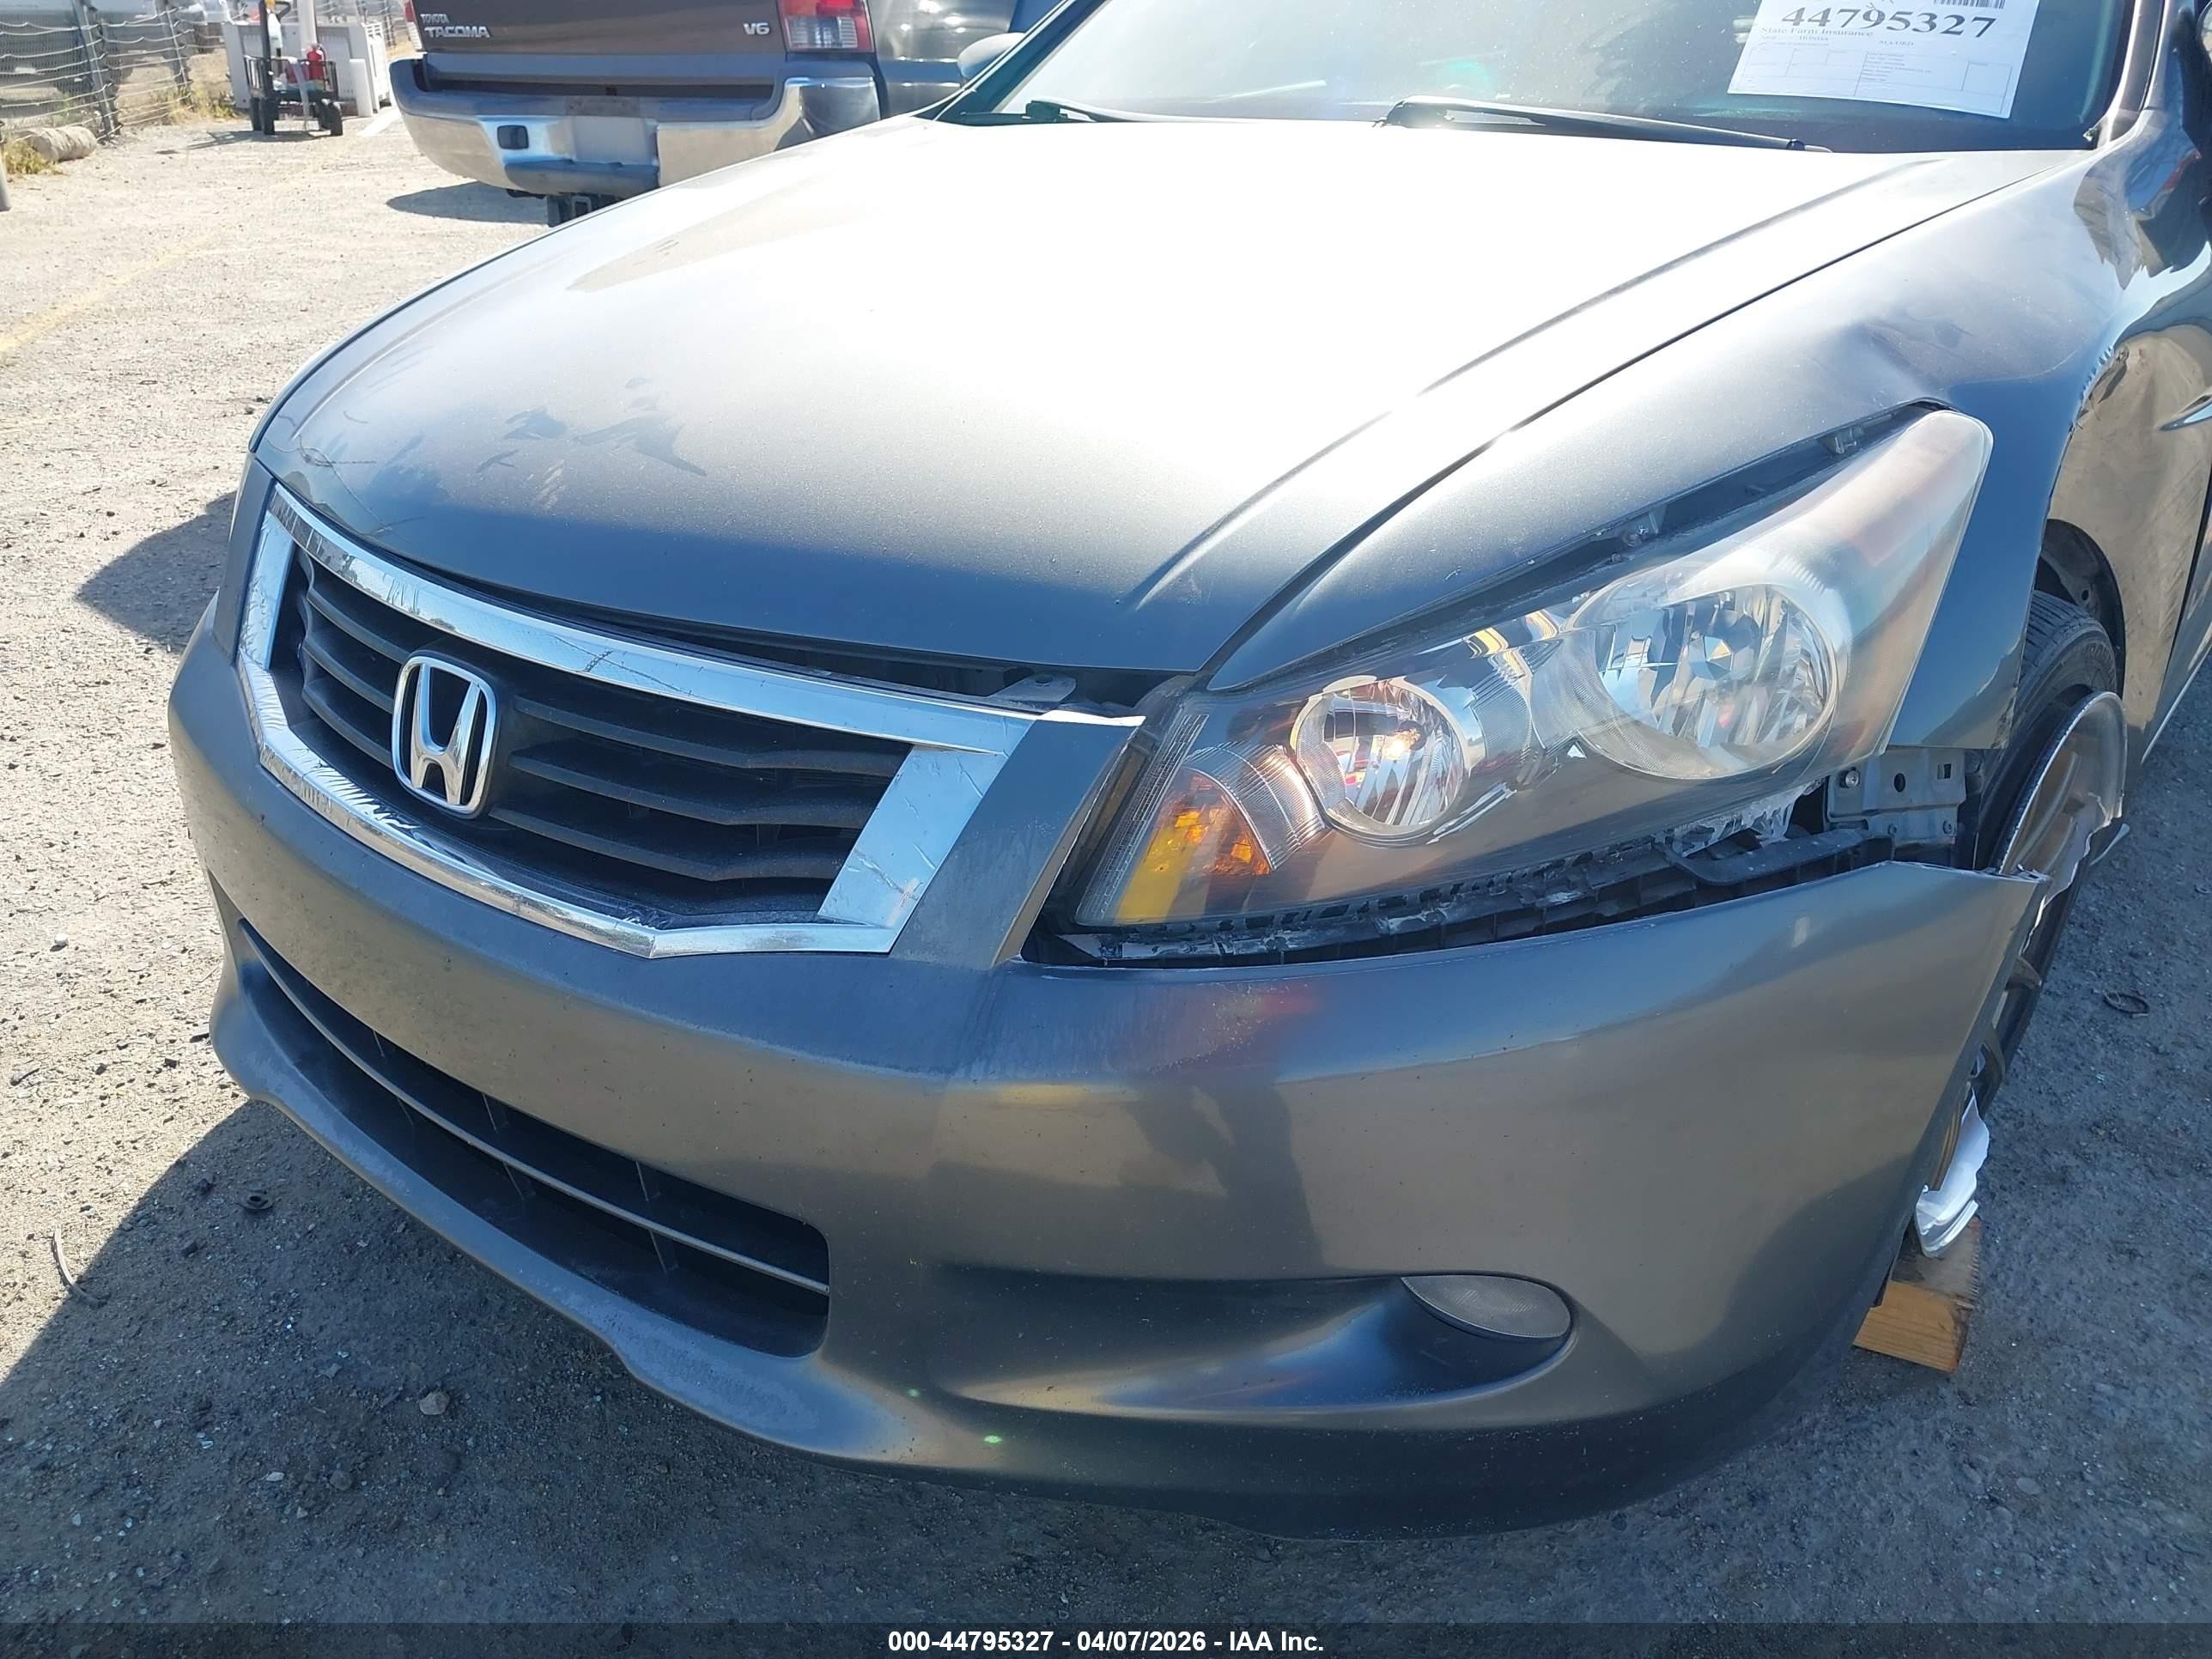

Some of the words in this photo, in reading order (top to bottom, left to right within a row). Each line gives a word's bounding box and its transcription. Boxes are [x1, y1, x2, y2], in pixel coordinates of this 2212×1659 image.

[420, 14, 449, 23] TOYOTA
[1781, 7, 1998, 39] 44795327
[425, 27, 489, 38] TACOMA
[744, 22, 769, 35] V6
[1821, 28, 1875, 37] Insurance
